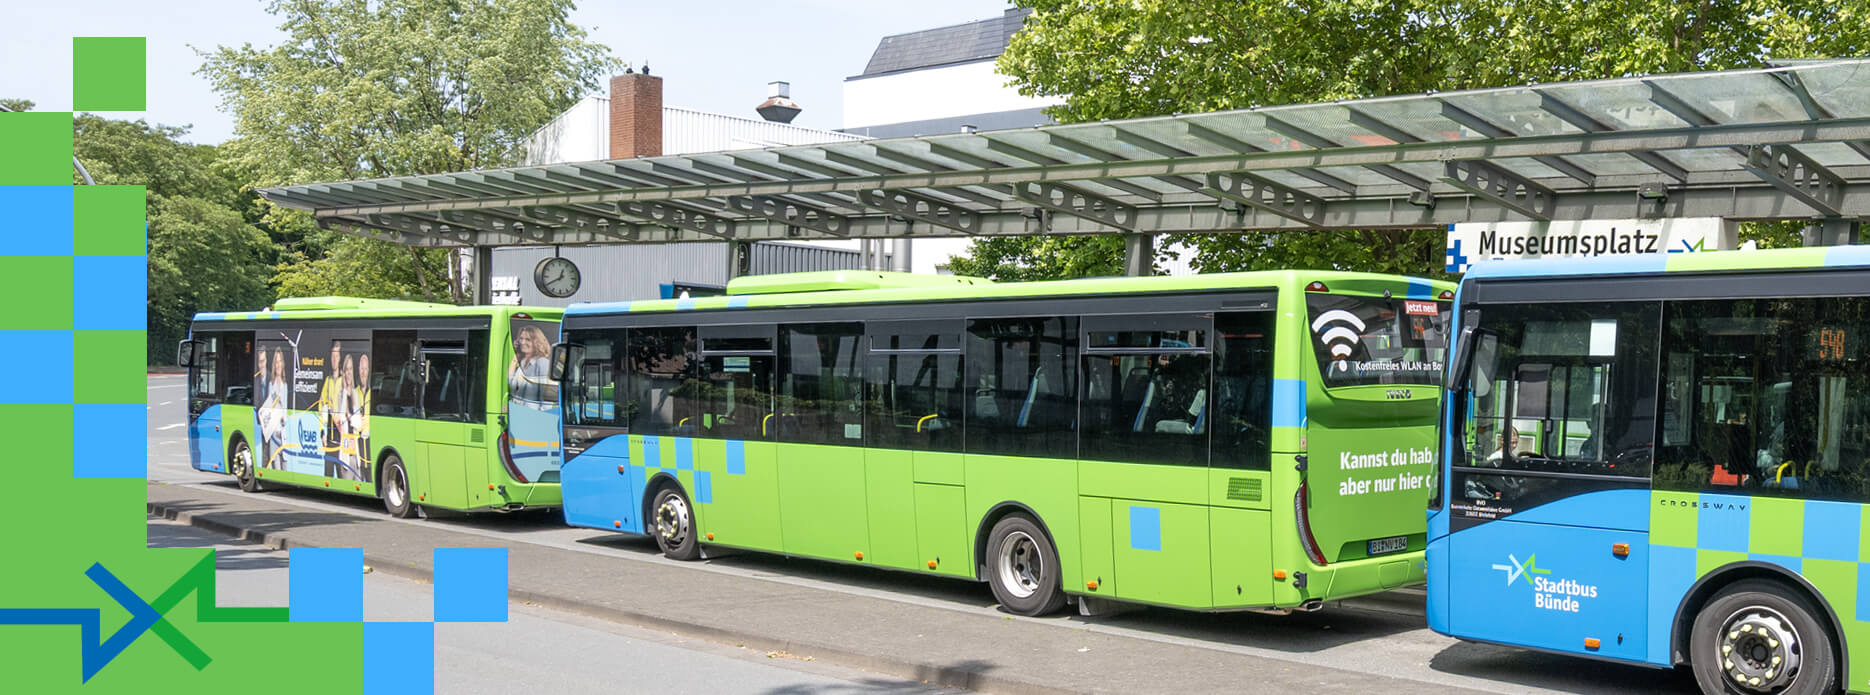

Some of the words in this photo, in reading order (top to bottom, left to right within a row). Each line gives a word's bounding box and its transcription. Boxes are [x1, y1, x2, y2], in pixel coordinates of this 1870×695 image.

[1479, 228, 1658, 256] Museumsplatz
[1406, 302, 1422, 314] Jetzt
[1423, 303, 1437, 314] neu!
[1355, 361, 1400, 372] Kostenfreies
[1400, 361, 1422, 371] WLAN
[1423, 363, 1432, 371] an
[1340, 451, 1388, 470] Kannst
[1391, 448, 1407, 466] du
[1410, 447, 1432, 464] hab
[1339, 477, 1371, 496] aber
[1374, 477, 1396, 493] nur
[1399, 472, 1424, 490] hier
[1660, 499, 1746, 511] CROSSWAY
[1534, 576, 1598, 598] Stadtbus
[1535, 592, 1580, 612] Bünde
